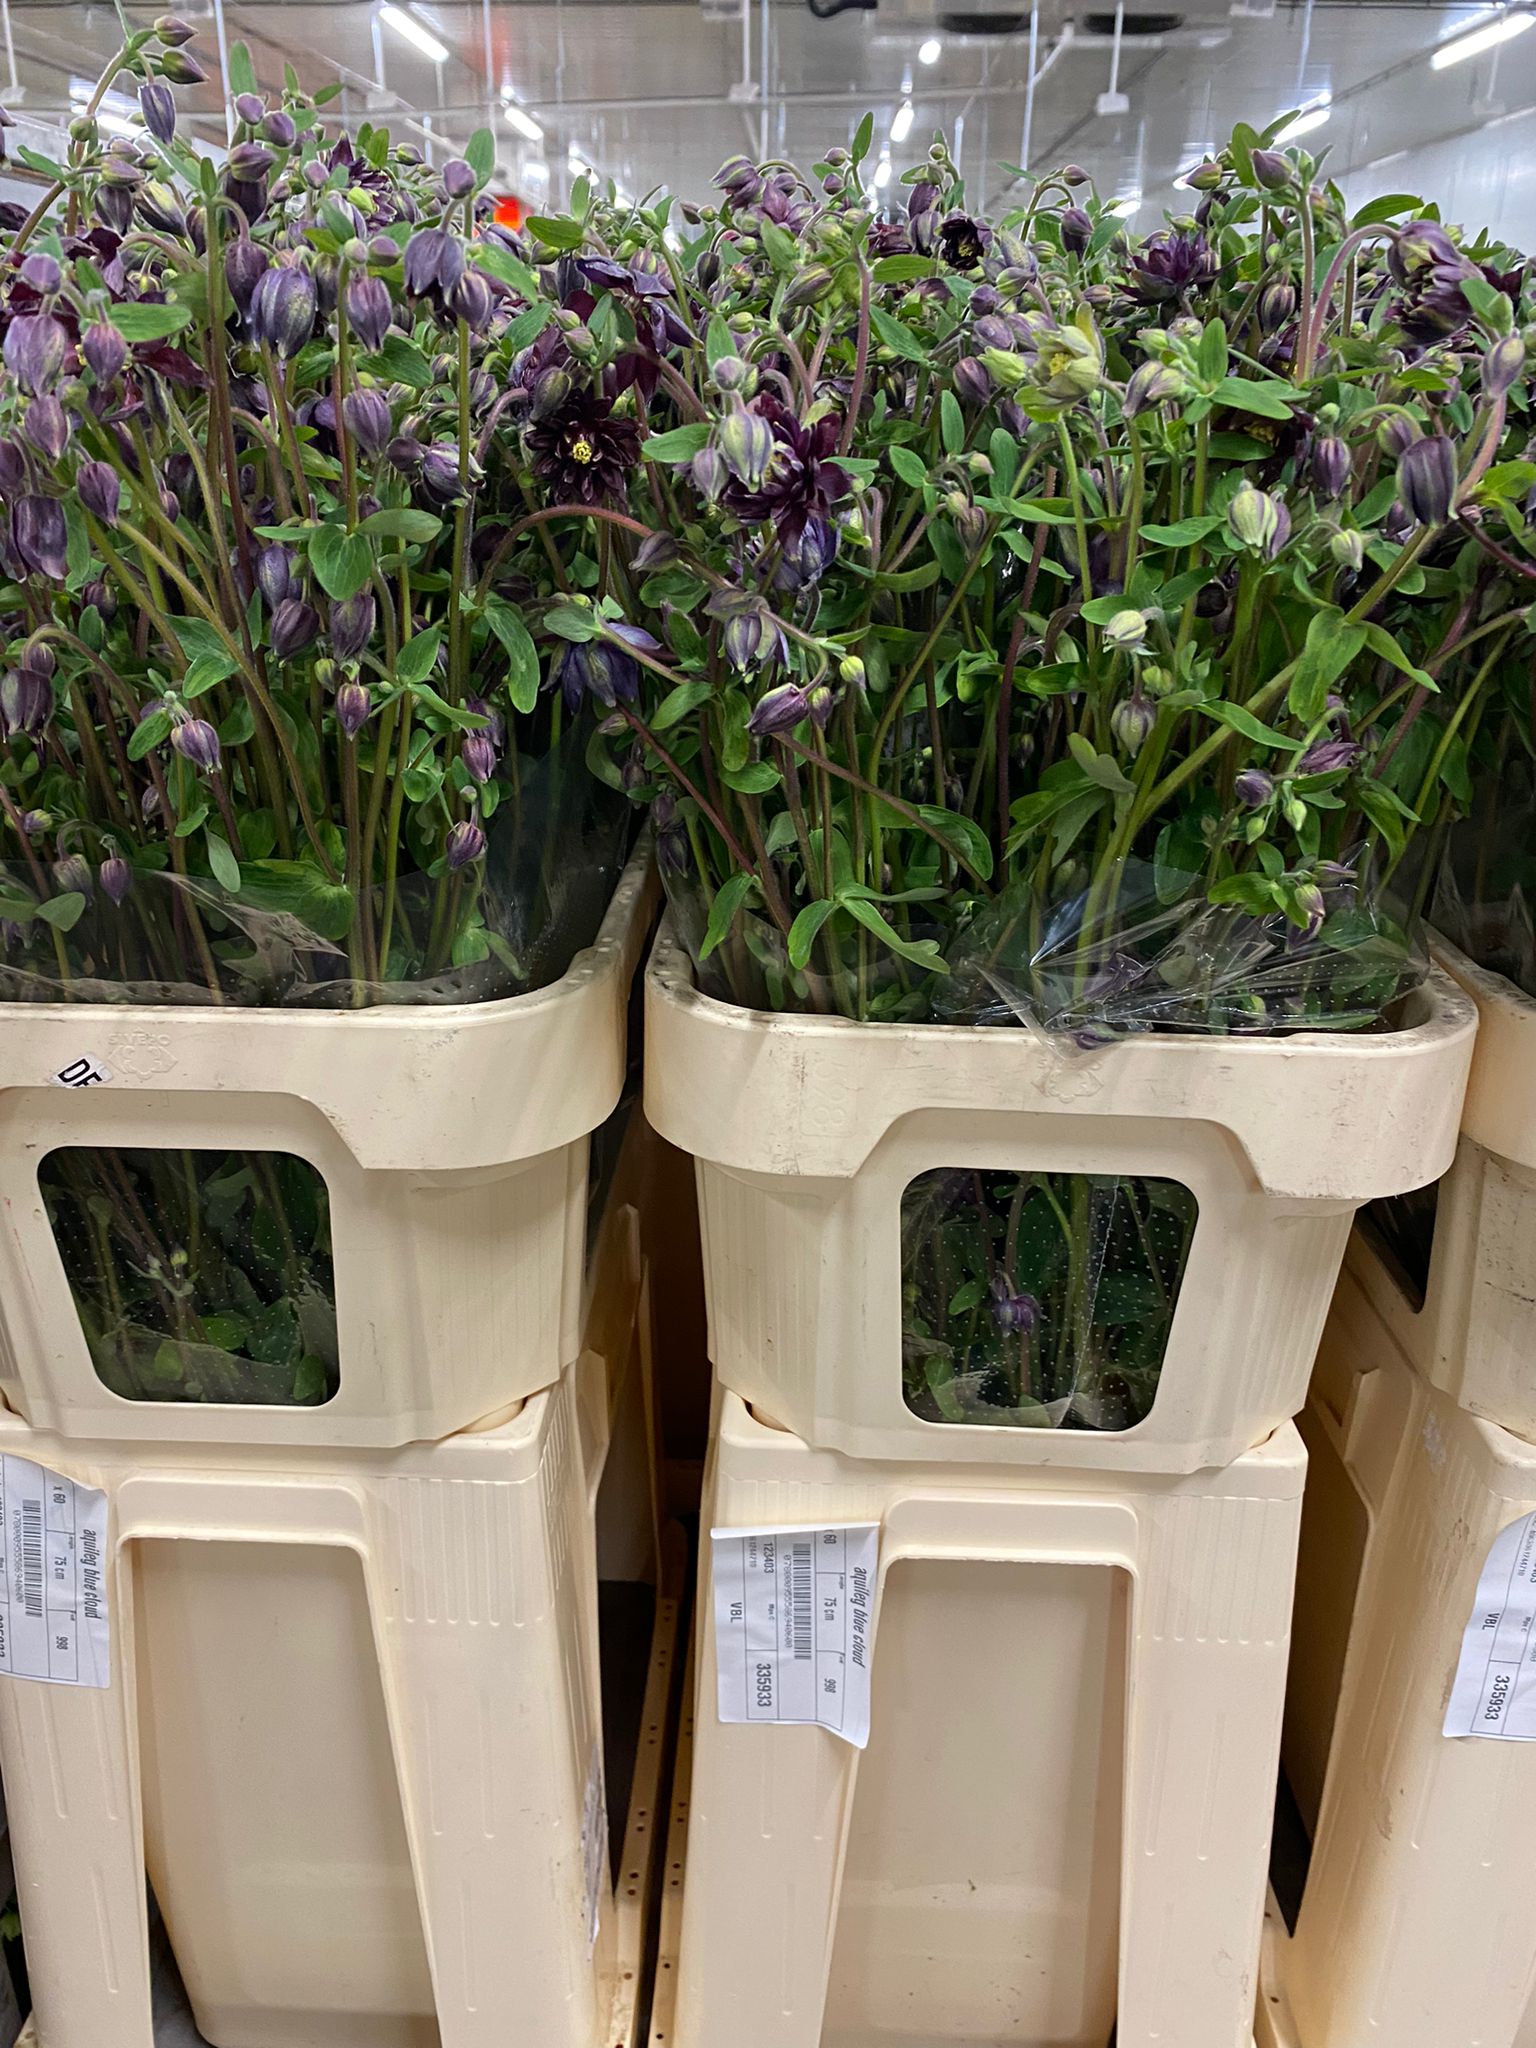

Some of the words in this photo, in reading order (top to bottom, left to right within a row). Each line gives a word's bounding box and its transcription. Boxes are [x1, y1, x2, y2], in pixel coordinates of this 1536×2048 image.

[53, 1493, 66, 1504] 60
[80, 1529, 99, 1565] aquileg
[824, 1535, 837, 1545] 60
[54, 1556, 67, 1566] 75
[763, 1542, 774, 1574] 123403
[55, 1568, 65, 1580] cm
[84, 1568, 101, 1590] blue
[850, 1567, 868, 1607] aquileg
[84, 1592, 102, 1619] cloud
[730, 1602, 743, 1623] VBL
[825, 1597, 837, 1607] 75
[825, 1609, 835, 1621] cm
[853, 1609, 868, 1632] blue
[1482, 1613, 1500, 1630] VBL
[56, 1635, 68, 1650] 998
[852, 1634, 866, 1668] cloud
[756, 1663, 771, 1708] 335933
[824, 1678, 837, 1693] 998
[1485, 1675, 1510, 1720] 335933
